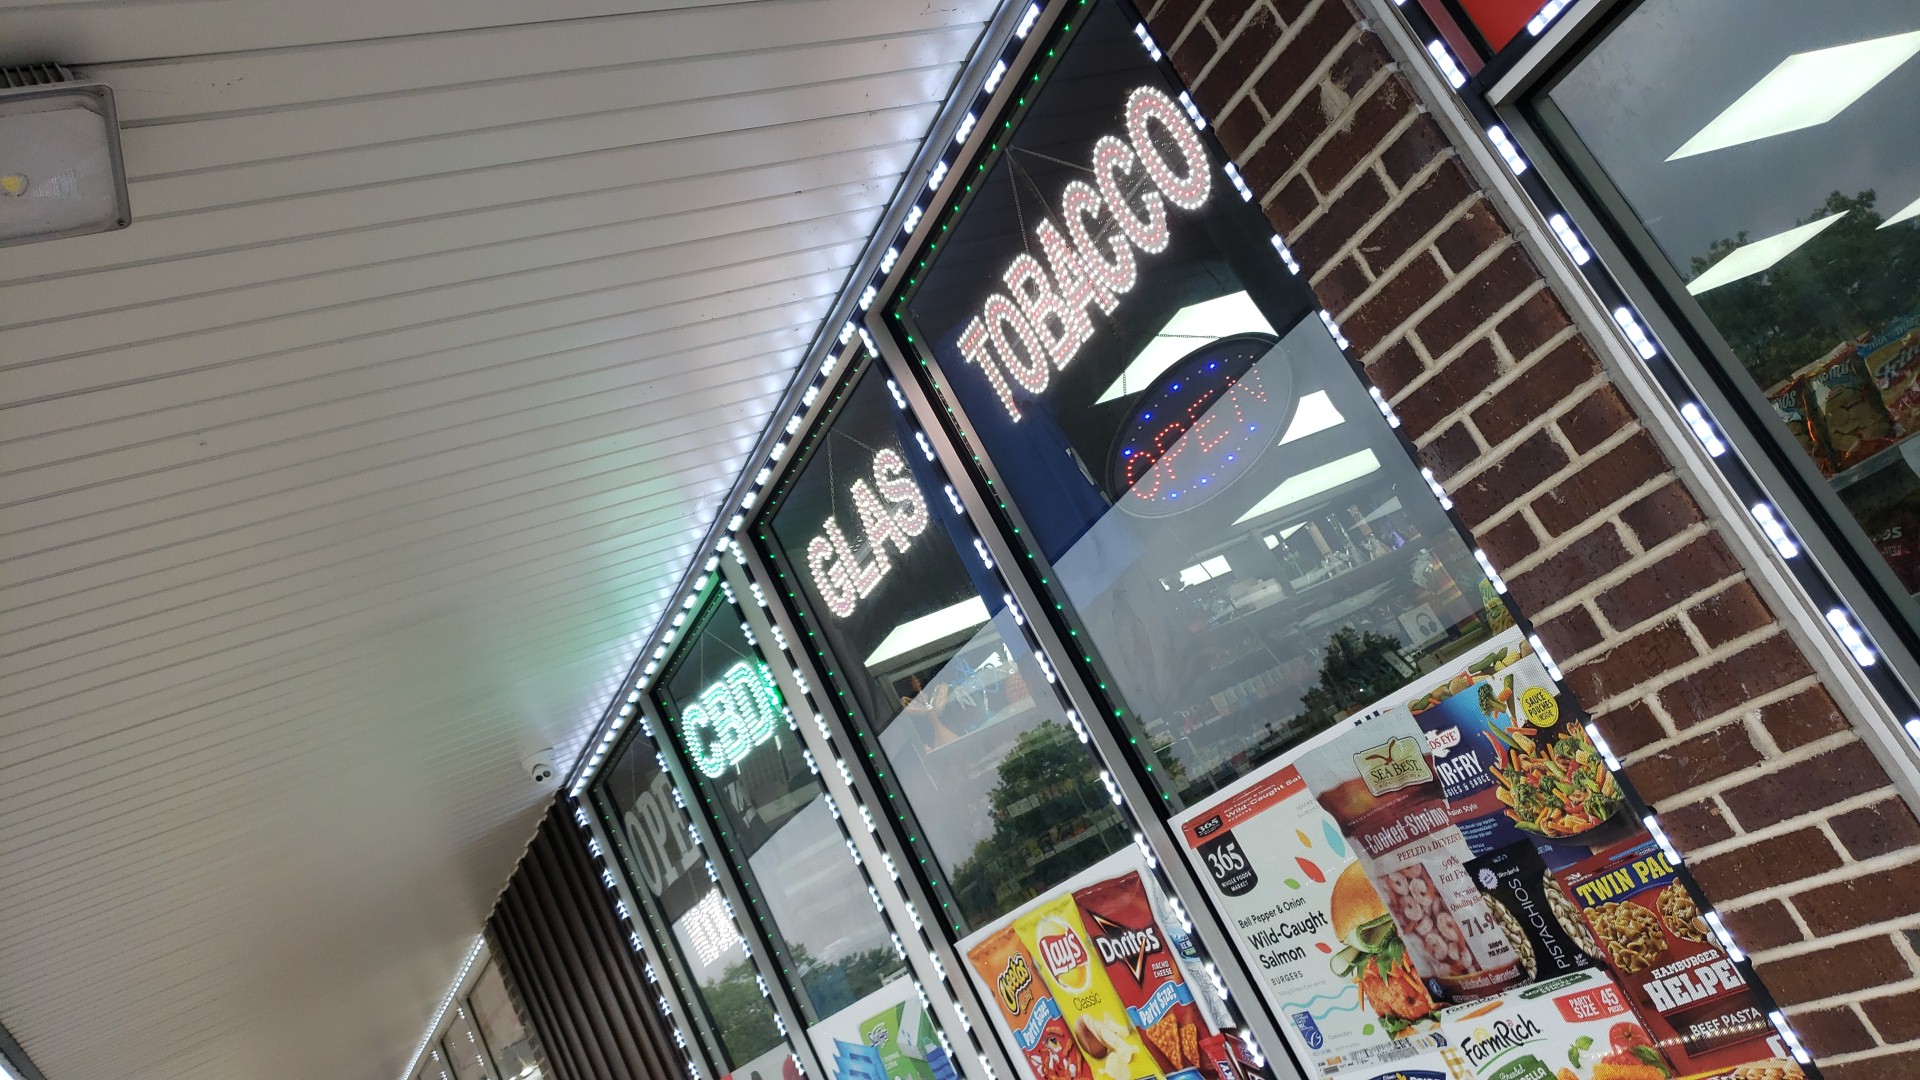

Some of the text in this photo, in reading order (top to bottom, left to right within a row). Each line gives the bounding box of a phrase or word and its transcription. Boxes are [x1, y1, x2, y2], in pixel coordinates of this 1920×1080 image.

[956, 85, 1212, 423] TOBACCO
[1126, 355, 1268, 499] OPEN
[1525, 692, 1546, 707] SAUCE
[1528, 700, 1553, 717] POUCHES
[682, 662, 777, 779] CBD
[1371, 767, 1393, 781] SEA
[1393, 759, 1420, 776] BEST
[1469, 773, 1491, 788] SAUCE
[1225, 784, 1285, 818] Wild-Caught
[1198, 816, 1220, 834] 365
[1365, 821, 1408, 854] Cooked
[1404, 806, 1450, 836] Shrimp
[1208, 842, 1245, 878] 365
[1397, 846, 1427, 861] PEELED
[1442, 855, 1459, 870] 99%
[1221, 871, 1252, 888] WHOLE FOODS
[1230, 881, 1249, 892] MARKET
[1439, 873, 1454, 885] Fat
[1576, 867, 1635, 905] TWIN
[1238, 896, 1306, 928] Bell Pepper & Onion
[1508, 878, 1571, 969] PISTACHIOS
[1247, 910, 1329, 950] Wild-Caught
[1041, 930, 1081, 977] Lay's
[1096, 927, 1160, 963] Doritos
[1152, 961, 1170, 971] NACHO
[1259, 946, 1307, 970] Salmon
[1651, 949, 1720, 979] HAMBURGER
[997, 952, 1031, 1015] Cheetos
[1153, 968, 1173, 979] CHEESE
[1270, 970, 1304, 986] BURGERS
[1073, 991, 1102, 1011] Classic
[1139, 984, 1177, 1026] Party Size!
[1568, 994, 1591, 1008] PARTY
[1600, 988, 1619, 1006] 45
[1573, 1003, 1599, 1019] SIZE
[1690, 1007, 1762, 1037] BEEF PASTA
[1022, 1015, 1041, 1047] Party
[1036, 1000, 1050, 1029] Size!
